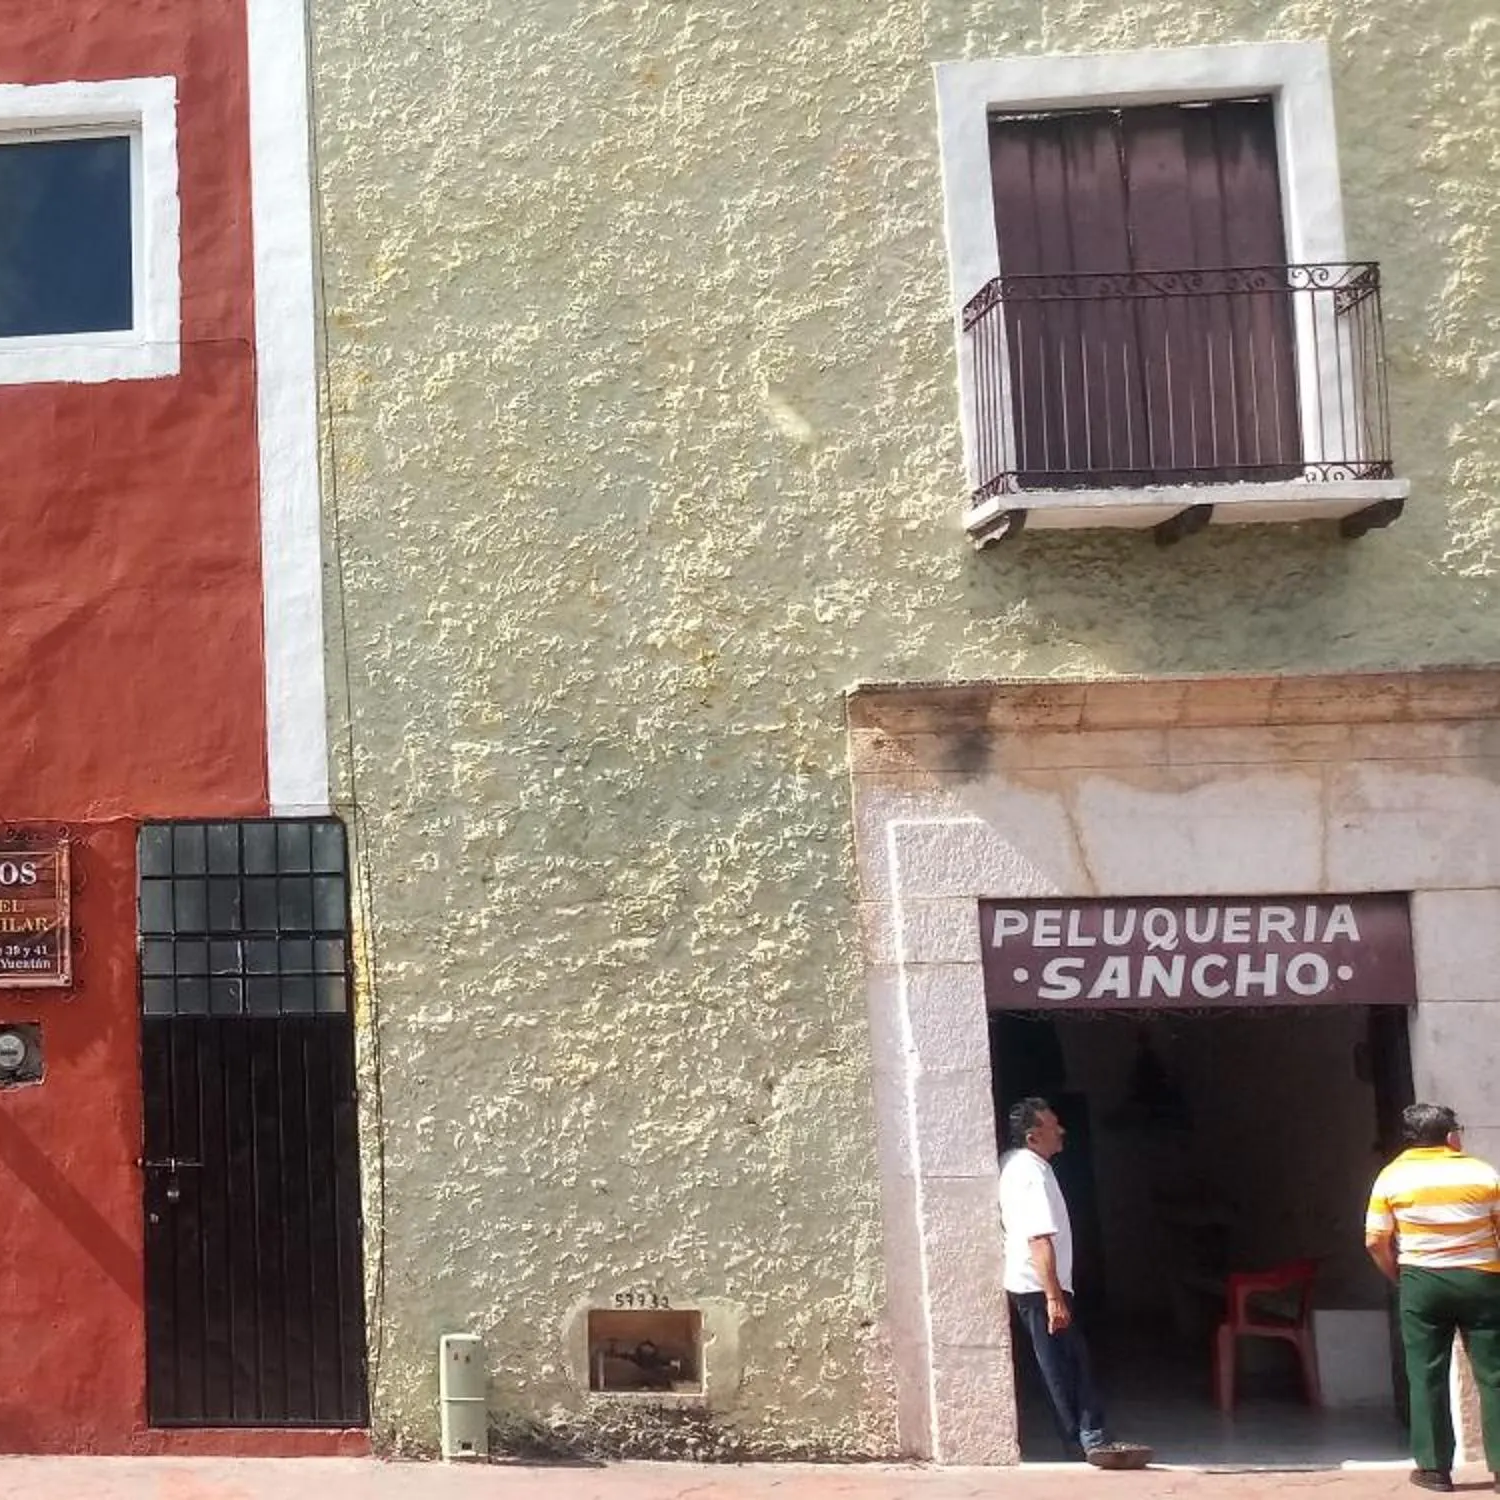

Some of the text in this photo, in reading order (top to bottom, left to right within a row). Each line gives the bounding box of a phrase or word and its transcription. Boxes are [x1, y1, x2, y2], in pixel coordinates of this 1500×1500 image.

[993, 904, 1361, 951] PELUQUERIA
[23, 947, 31, 958] y
[33, 945, 48, 955] 41
